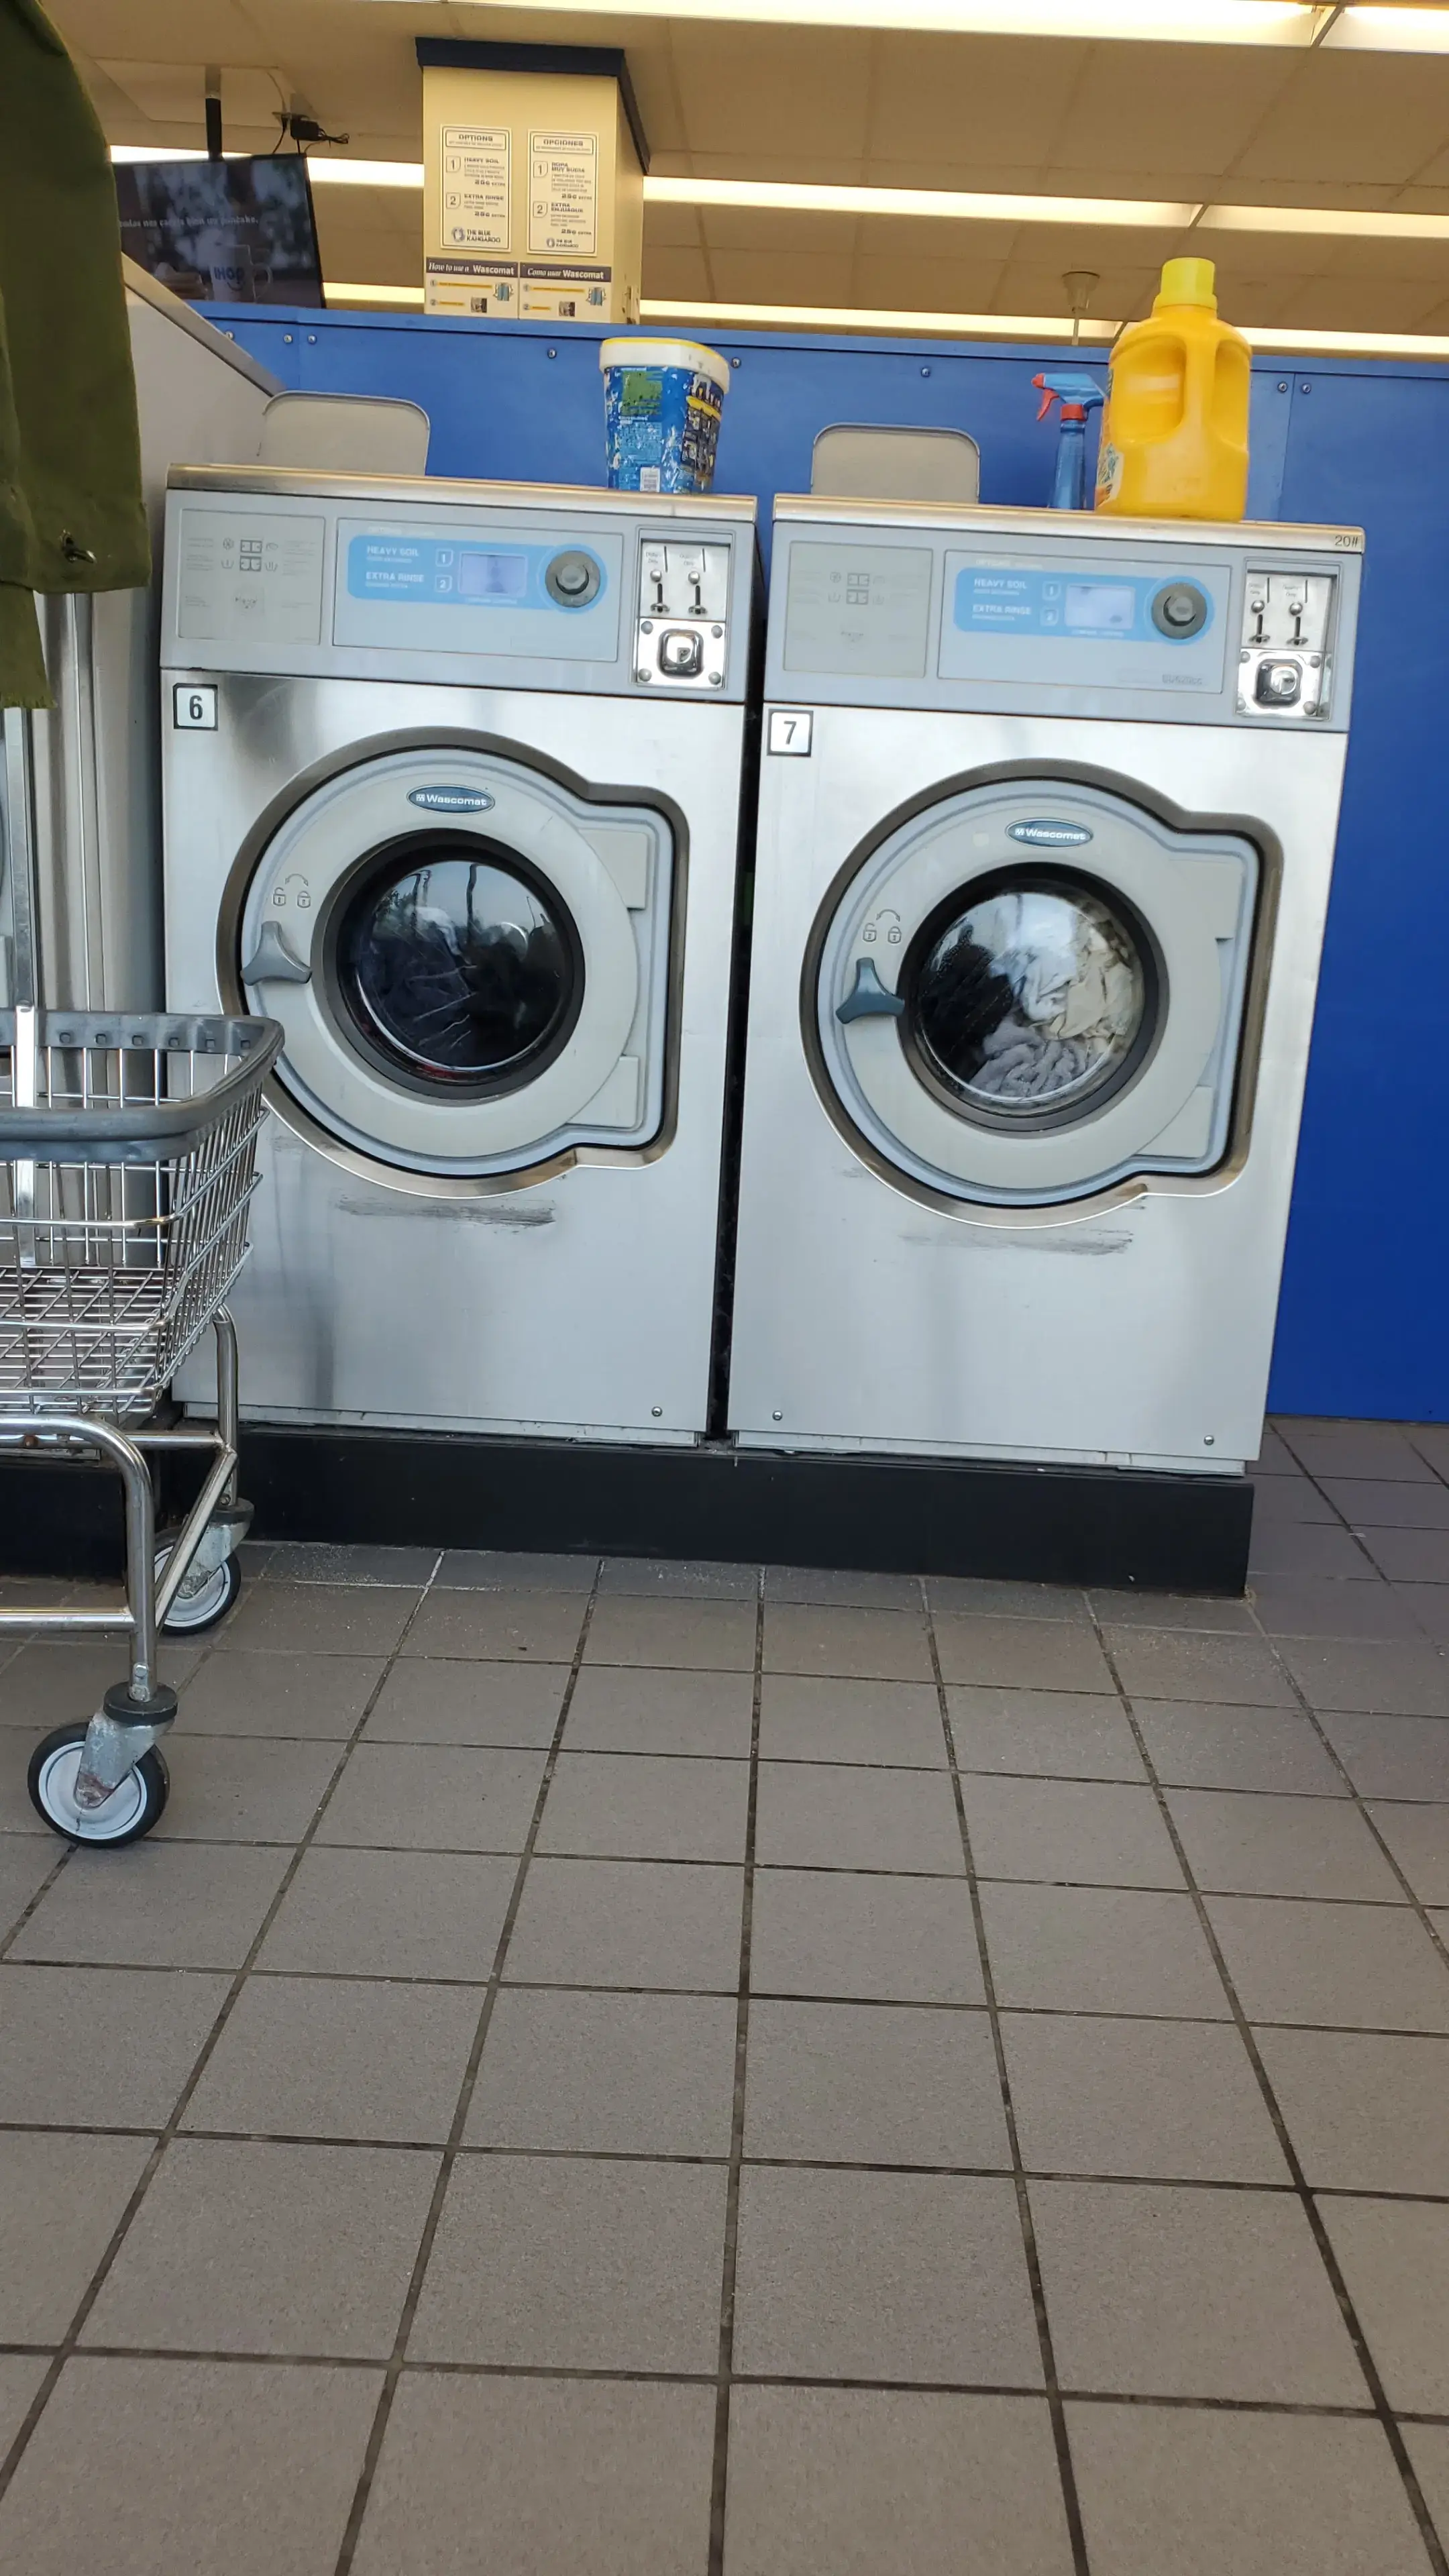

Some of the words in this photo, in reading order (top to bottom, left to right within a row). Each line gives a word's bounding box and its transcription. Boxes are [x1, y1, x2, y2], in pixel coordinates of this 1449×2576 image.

[450, 196, 456, 205] 2
[537, 205, 543, 214] 2
[429, 262, 444, 271] How
[445, 264, 452, 272] to
[472, 264, 515, 276] Wascomat
[527, 268, 546, 277] Como
[562, 269, 604, 280] Wascomat
[366, 545, 397, 555] HEAVY
[399, 548, 419, 557] SOIL
[366, 571, 396, 581] EXTRA
[397, 573, 425, 583] RINSE
[439, 580, 446, 589] 2
[974, 578, 1006, 588] HEAVY
[1007, 580, 1028, 590] SOIL
[972, 604, 1003, 614] EXTRA
[1004, 606, 1032, 615] RINSE
[1046, 611, 1054, 621] 2
[189, 695, 203, 720] 6
[783, 720, 797, 745] 7
[426, 794, 488, 806] Wascomat
[1025, 828, 1086, 841] Wascomat
